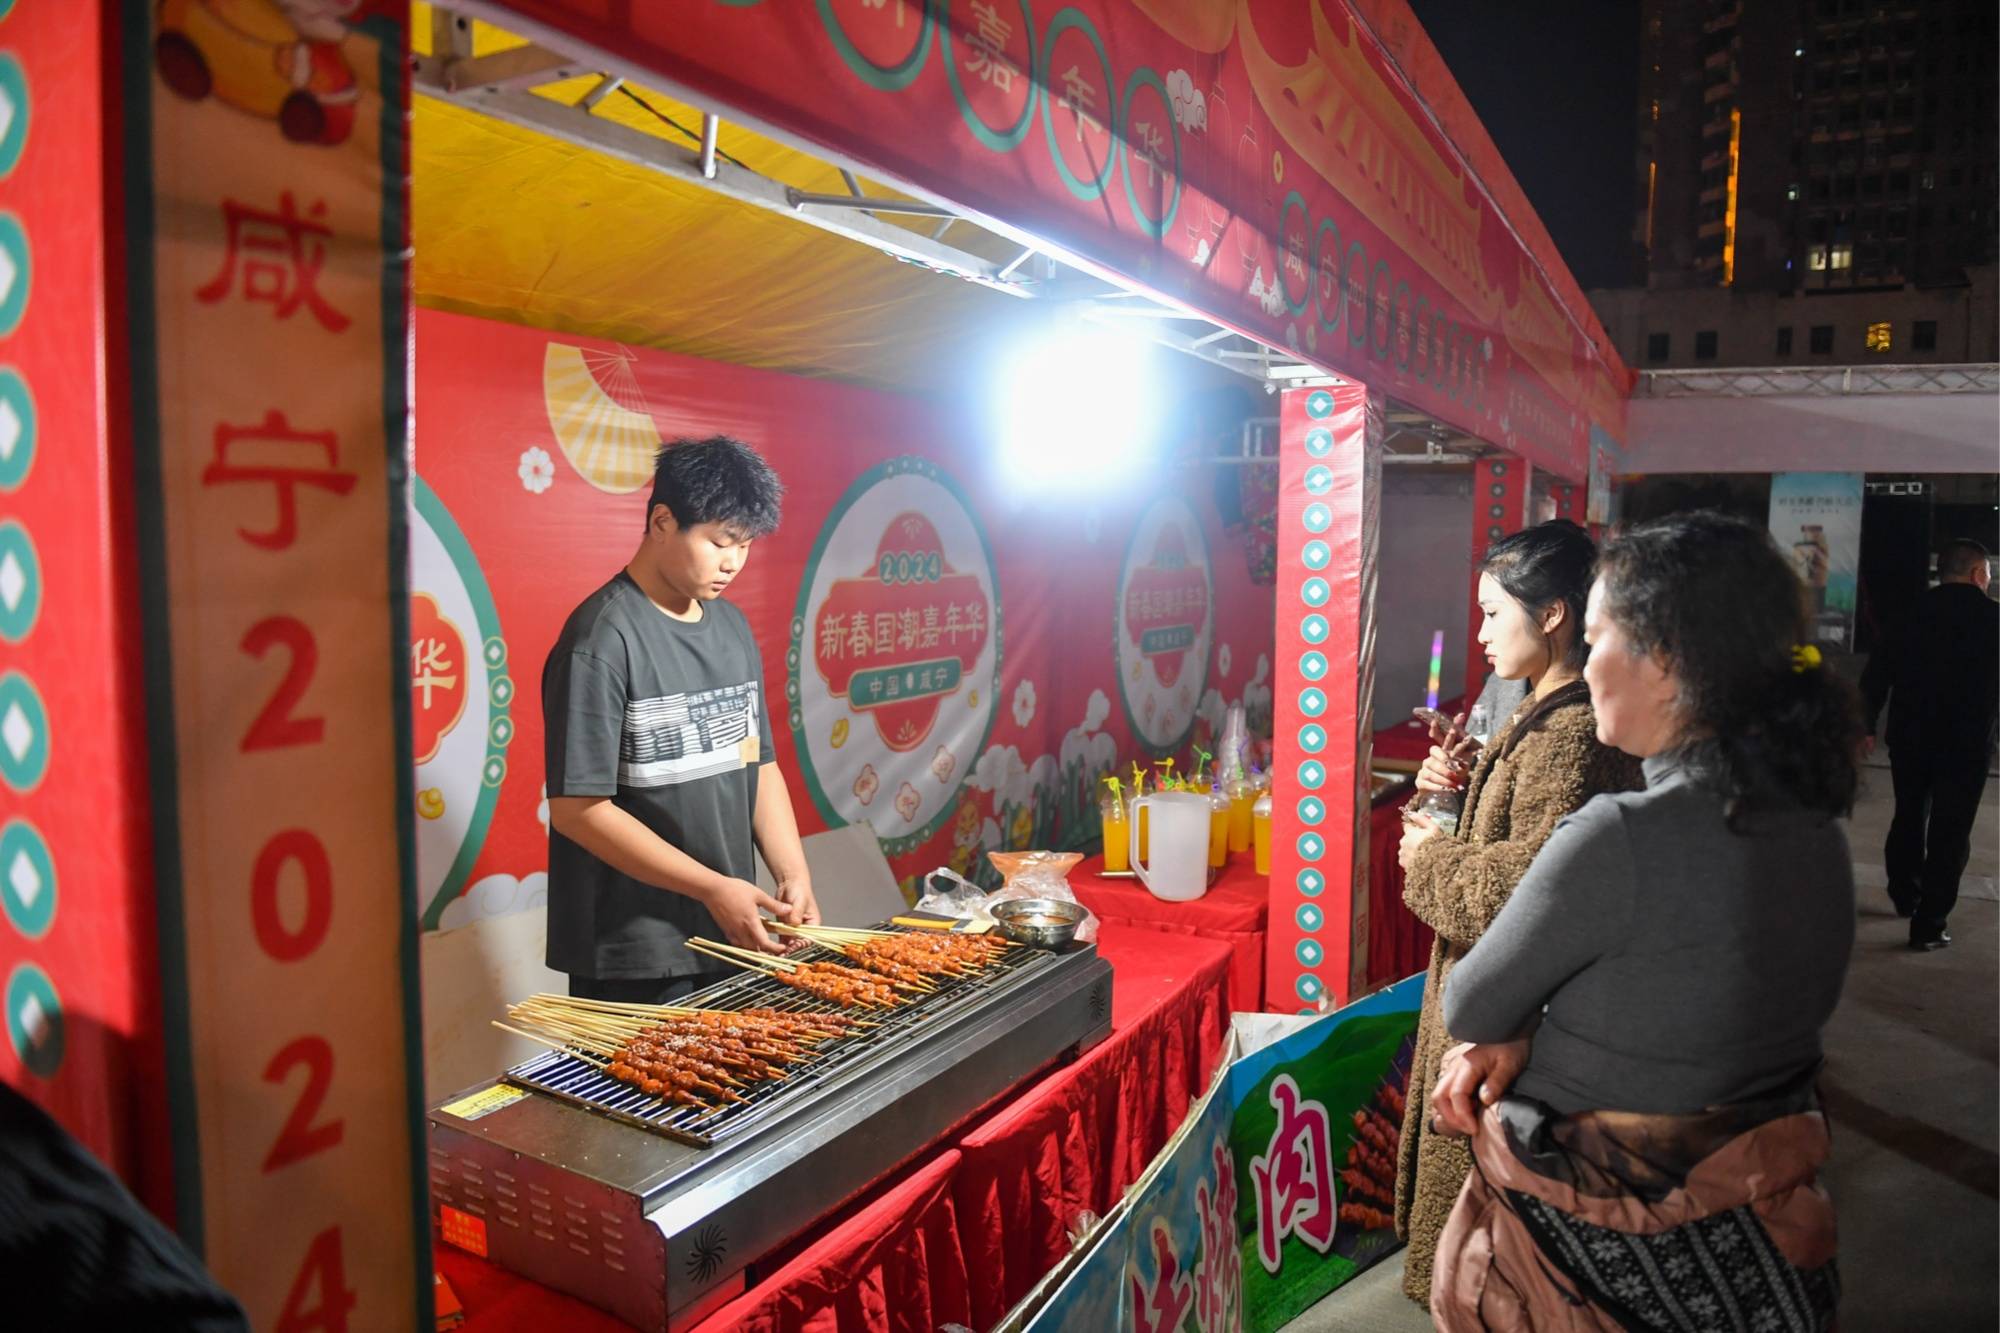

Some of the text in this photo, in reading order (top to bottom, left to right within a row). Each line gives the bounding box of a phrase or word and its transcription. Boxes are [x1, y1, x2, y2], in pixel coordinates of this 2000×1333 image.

[862, 0, 1169, 188] 嘉年华
[882, 557, 939, 578] 2024
[820, 602, 985, 660] 新春国潮嘉年华
